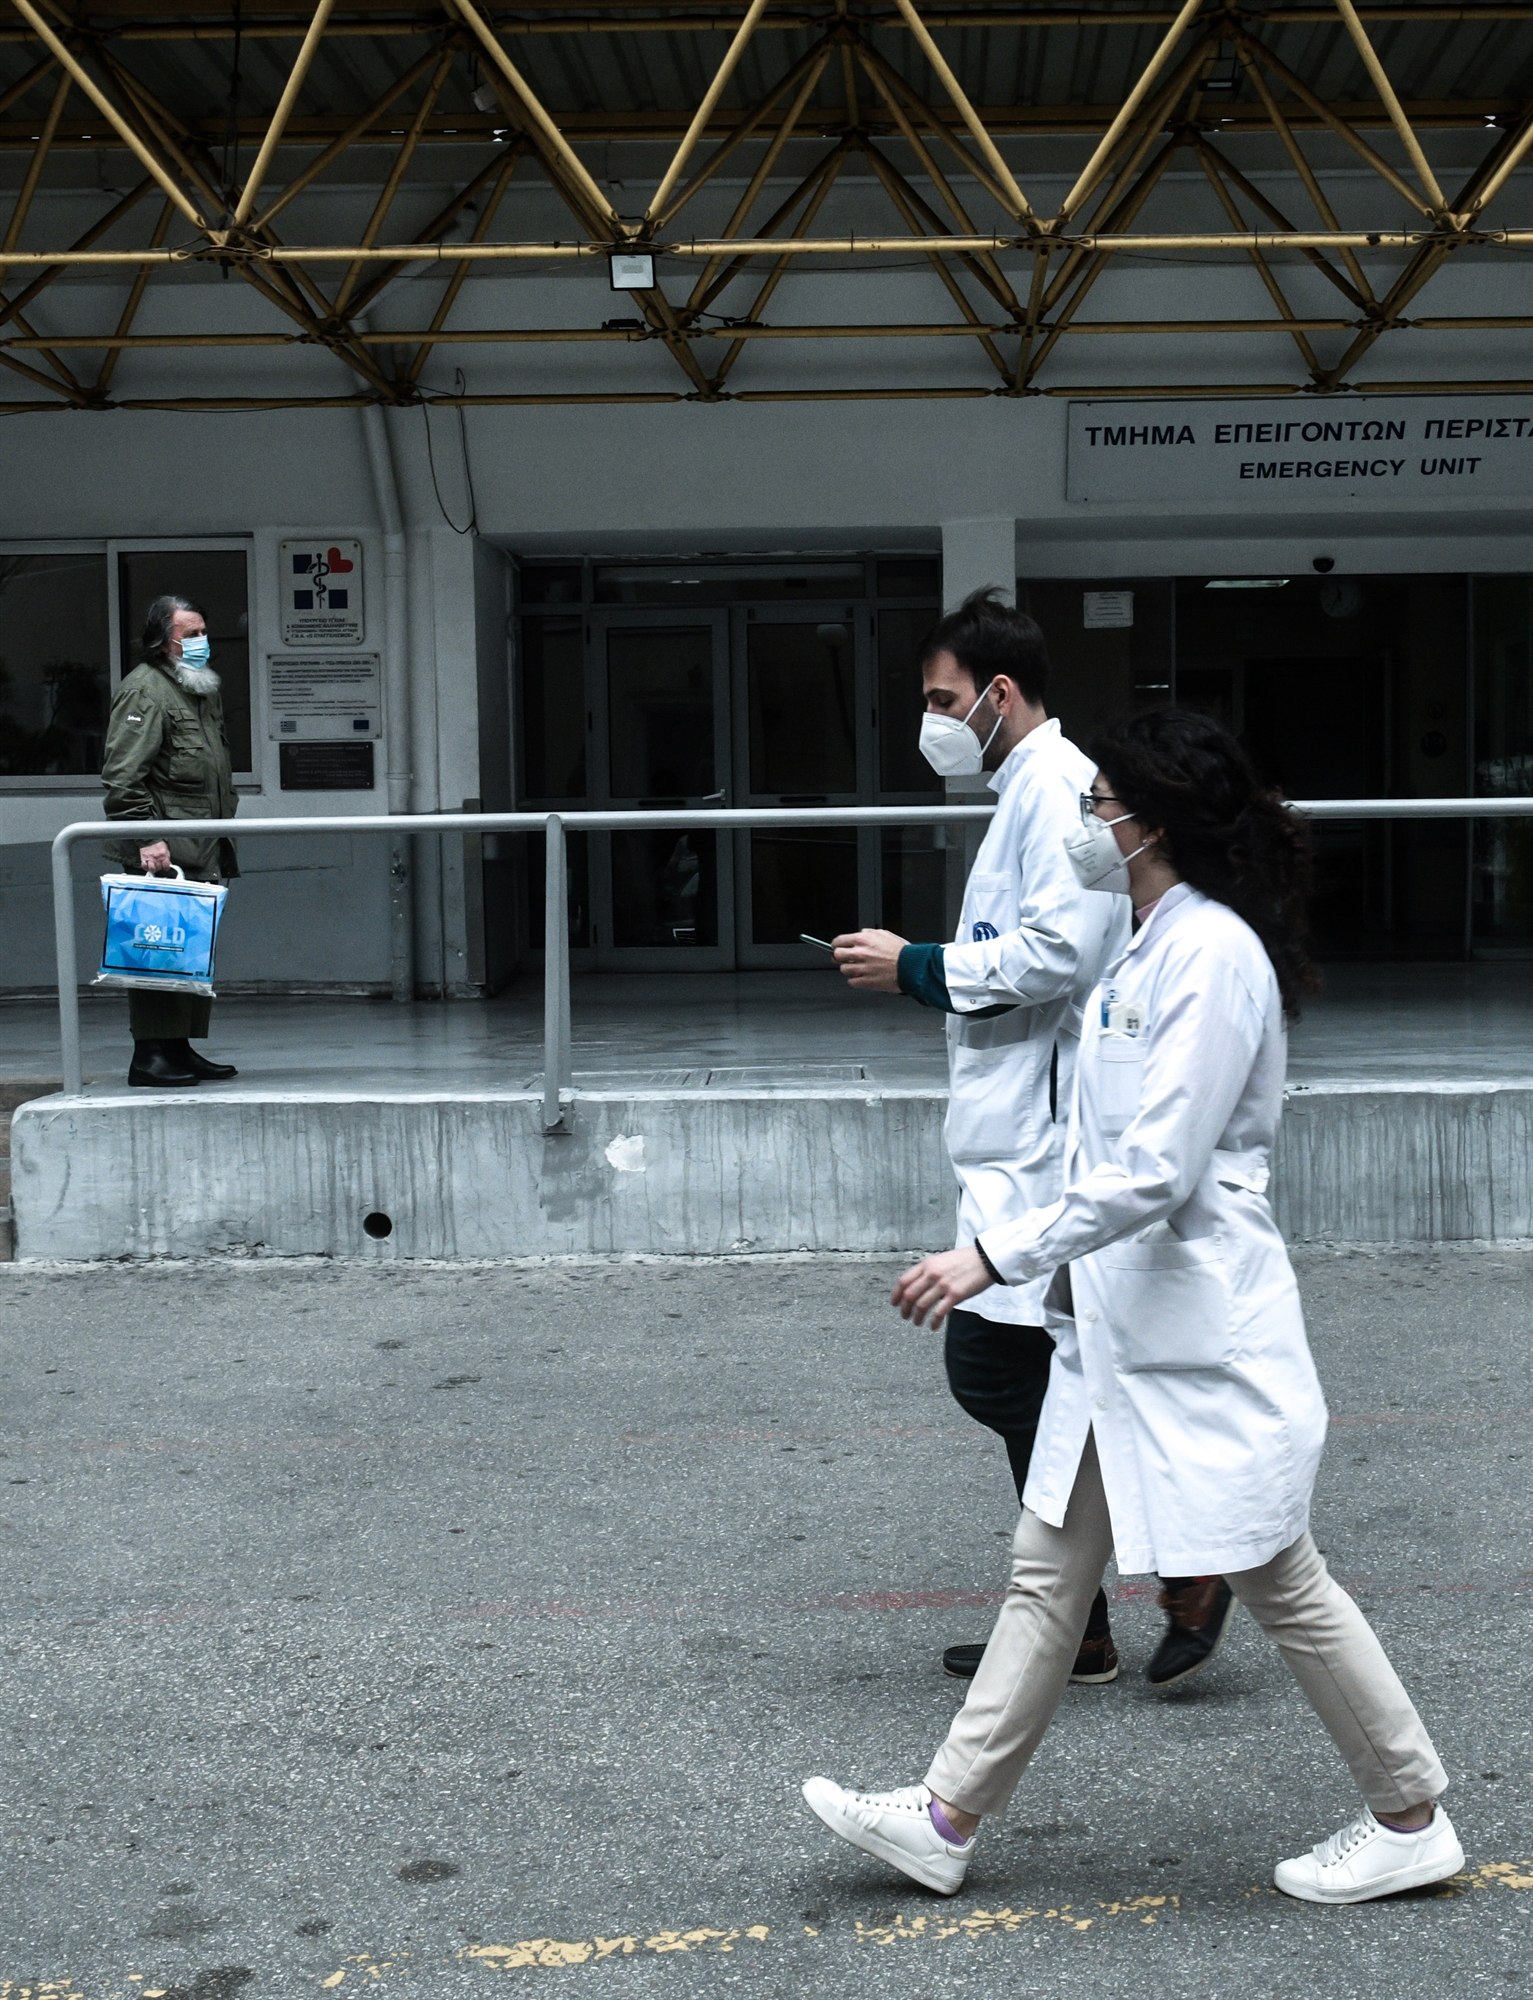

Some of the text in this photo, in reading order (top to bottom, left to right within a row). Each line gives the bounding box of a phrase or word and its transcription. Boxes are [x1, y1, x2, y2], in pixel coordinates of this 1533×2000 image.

[1085, 425, 1196, 446] ΤΜΗΜΑ
[1214, 420, 1406, 444] ΕΠΕΙΓΟΝΤΩΝ
[1239, 457, 1482, 479] EMERGENCY UNIT
